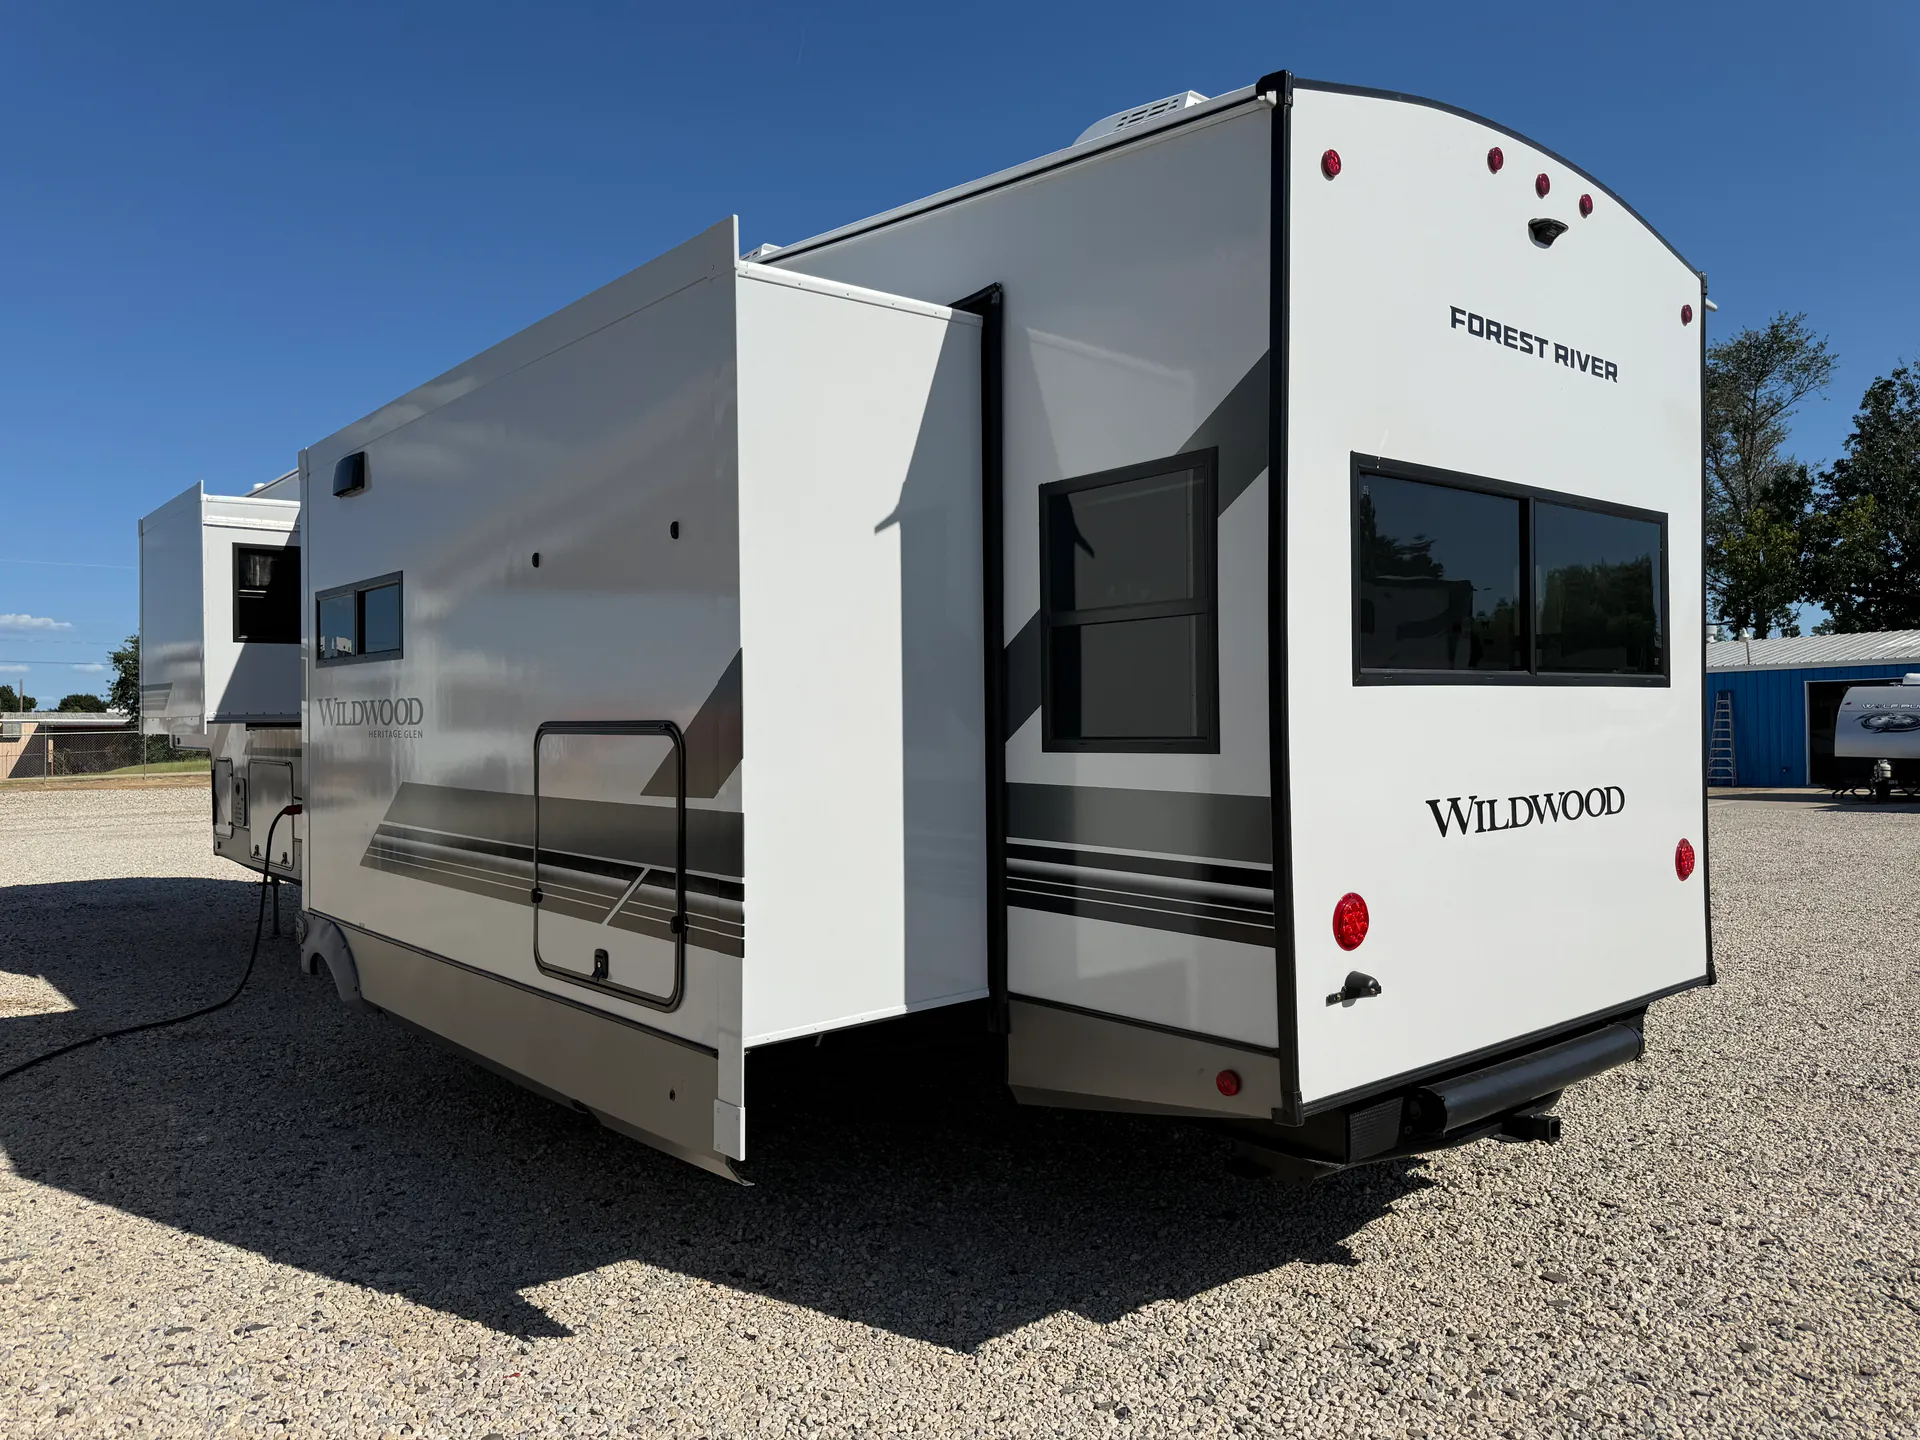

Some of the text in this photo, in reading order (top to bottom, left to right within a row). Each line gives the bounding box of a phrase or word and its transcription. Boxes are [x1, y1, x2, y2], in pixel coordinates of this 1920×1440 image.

[1449, 305, 1618, 384] FOREST RIVER
[317, 697, 424, 726] WILDWOOD
[368, 729, 423, 739] HERITAGE GLEN
[1425, 785, 1626, 838] WILDWOOD
